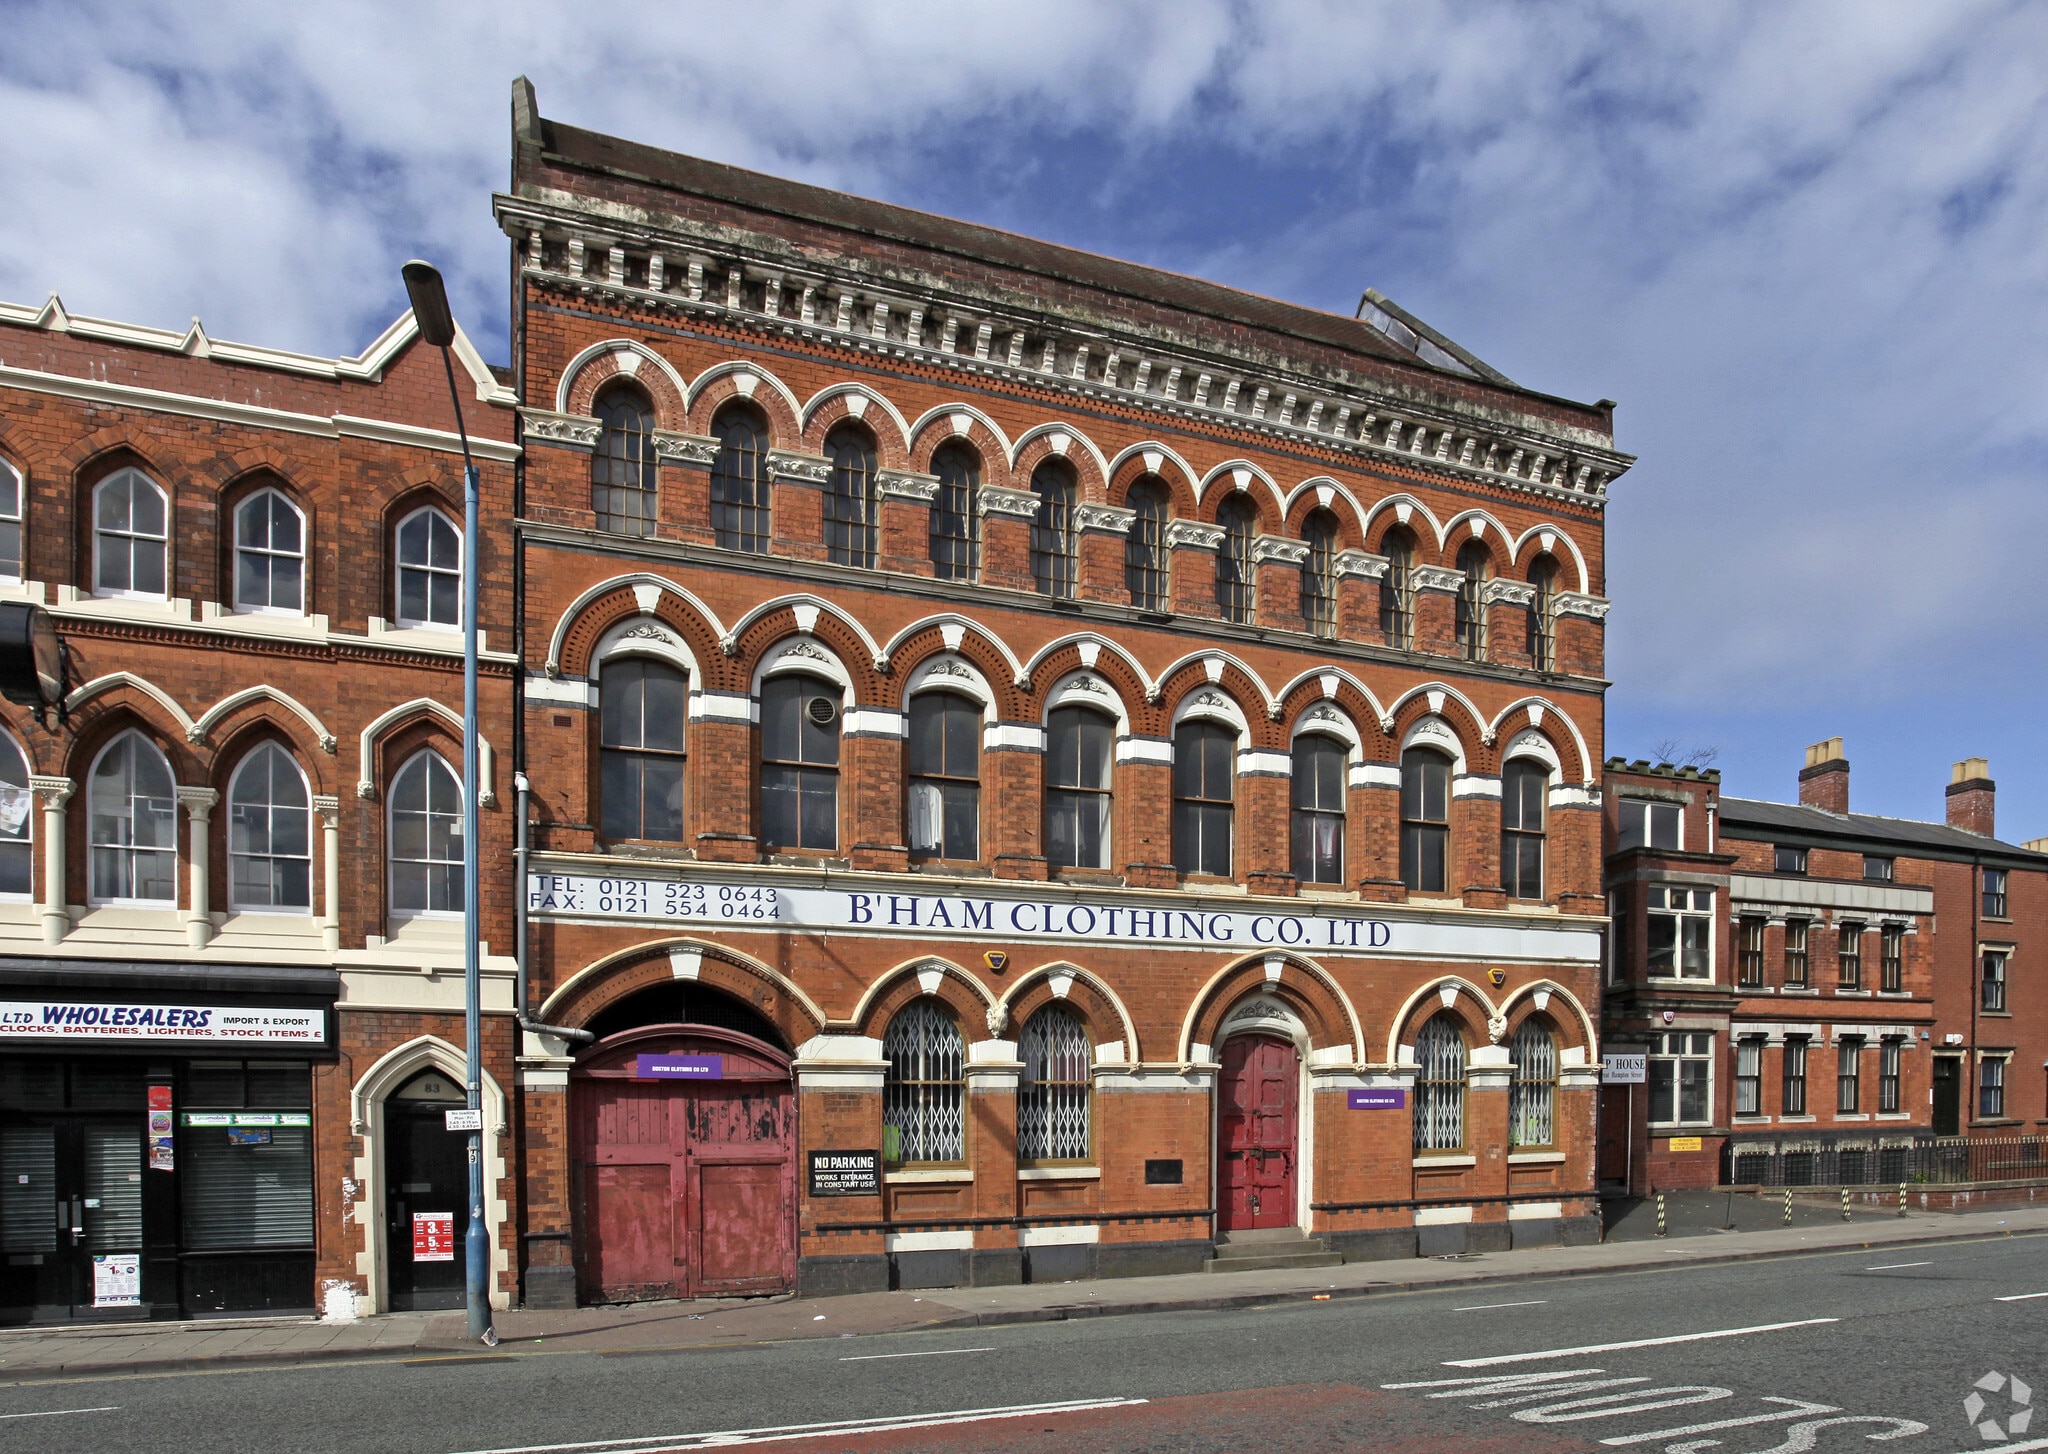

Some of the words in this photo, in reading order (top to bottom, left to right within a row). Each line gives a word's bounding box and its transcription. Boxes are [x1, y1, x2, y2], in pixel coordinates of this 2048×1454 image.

[536, 875, 585, 893] TEL:
[599, 879, 648, 896] 0121
[665, 883, 705, 899] 523
[719, 886, 777, 903] 0643
[530, 892, 585, 910] FAX:
[599, 896, 648, 913] 0121
[665, 900, 708, 916] 554
[721, 903, 780, 919] 0464
[848, 894, 995, 930] B'HAM
[1010, 903, 1234, 941] CLOTHING
[1251, 916, 1312, 945] CO.
[1327, 919, 1391, 947] LTD
[43, 1005, 212, 1029] WHOLESALERS
[223, 1016, 260, 1025] IMPORT
[263, 1017, 270, 1025] &
[273, 1018, 310, 1026] EXPORT
[0, 1025, 59, 1034] CLOCKS,
[63, 1026, 142, 1035] BATTERIES,
[147, 1028, 216, 1037] LIGHTERS,
[220, 1029, 264, 1037] STOCK
[268, 1030, 309, 1038] ITEMS
[1616, 1058, 1645, 1070] HOUSE
[424, 1083, 440, 1093] 83
[815, 1157, 828, 1168] NO
[831, 1157, 874, 1168] PARKING
[840, 1173, 874, 1181] ENTRANCE
